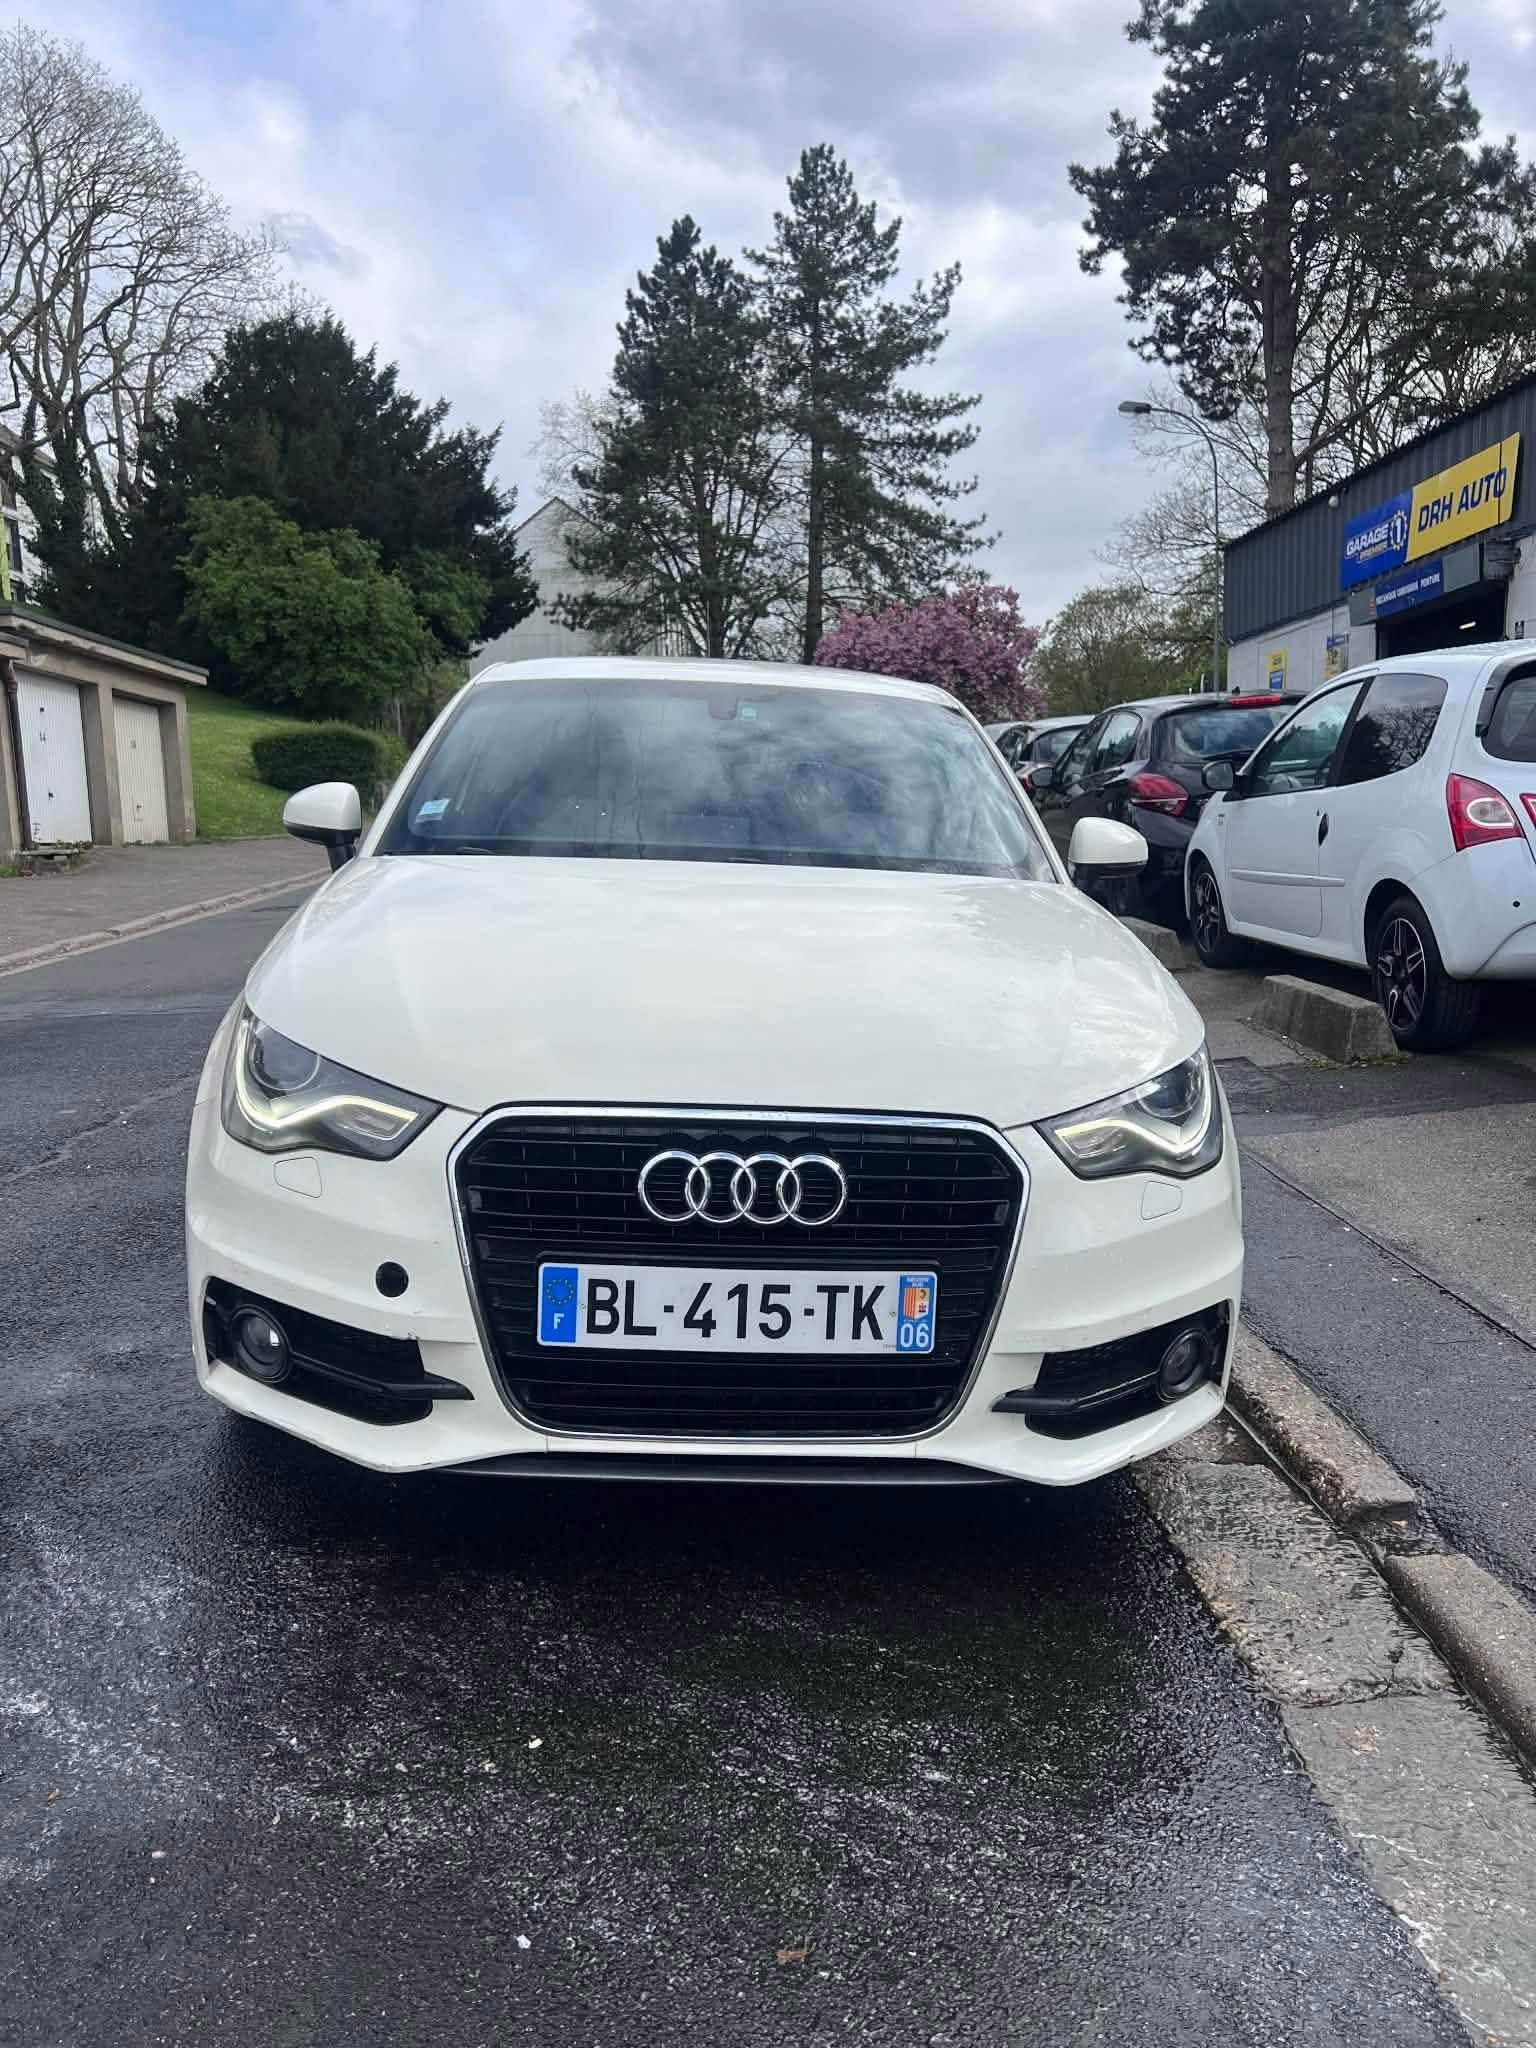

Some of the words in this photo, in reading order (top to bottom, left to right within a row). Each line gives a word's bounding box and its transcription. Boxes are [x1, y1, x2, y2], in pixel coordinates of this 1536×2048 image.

[1417, 492, 1453, 533] DRH
[1456, 467, 1508, 515] AUTO
[1345, 522, 1389, 556] GARAGE
[552, 1312, 565, 1330] F
[586, 1278, 886, 1341] BL-415-TK
[900, 1322, 929, 1348] 06
